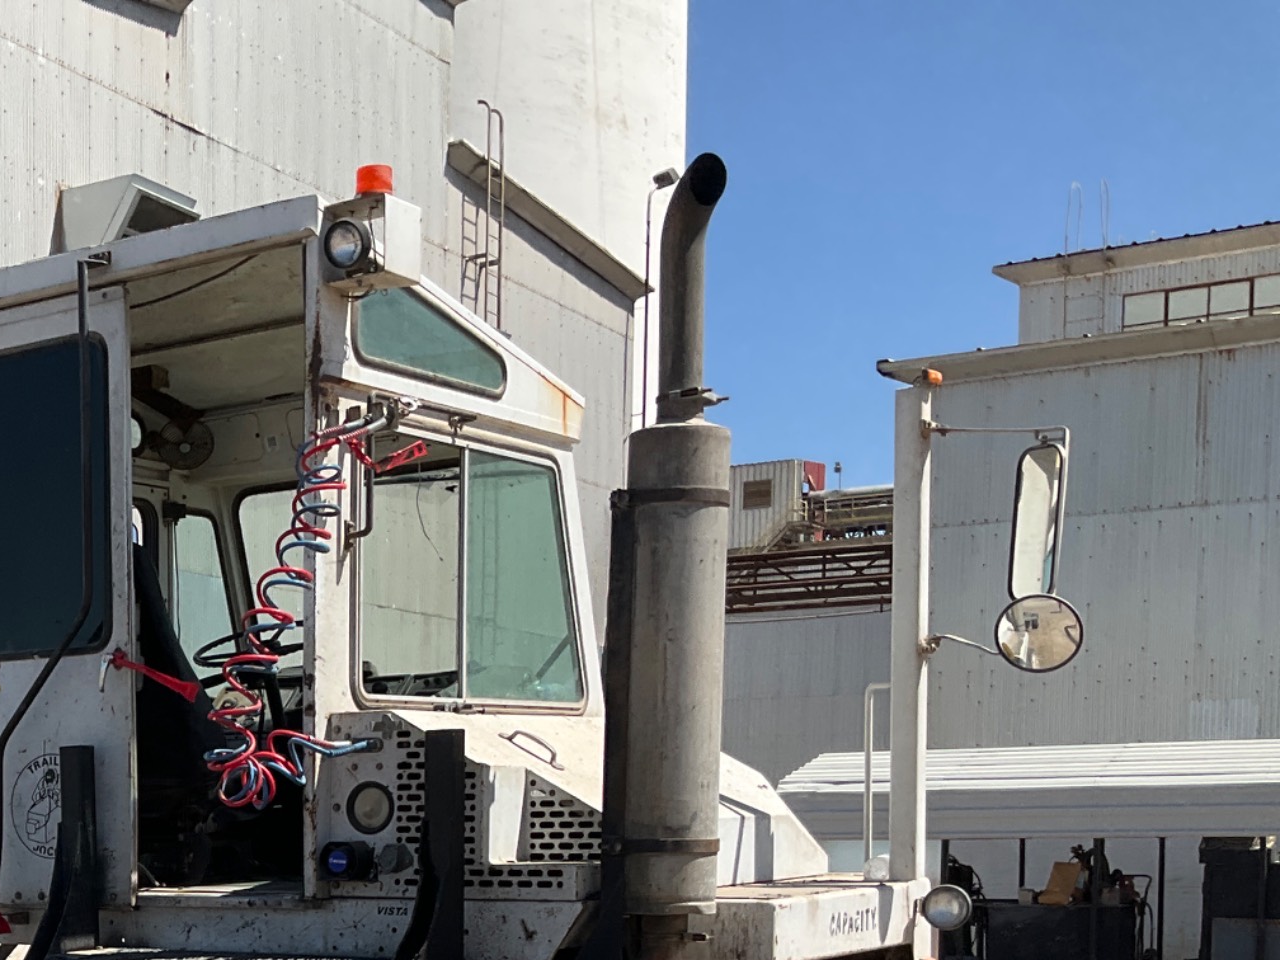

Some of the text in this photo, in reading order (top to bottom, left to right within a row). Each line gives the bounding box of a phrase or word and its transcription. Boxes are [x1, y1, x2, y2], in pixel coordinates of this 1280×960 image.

[27, 757, 59, 774] TRAIL
[32, 845, 55, 856] JOC
[377, 906, 408, 916] VISTA
[829, 907, 877, 936] CAPACITY
